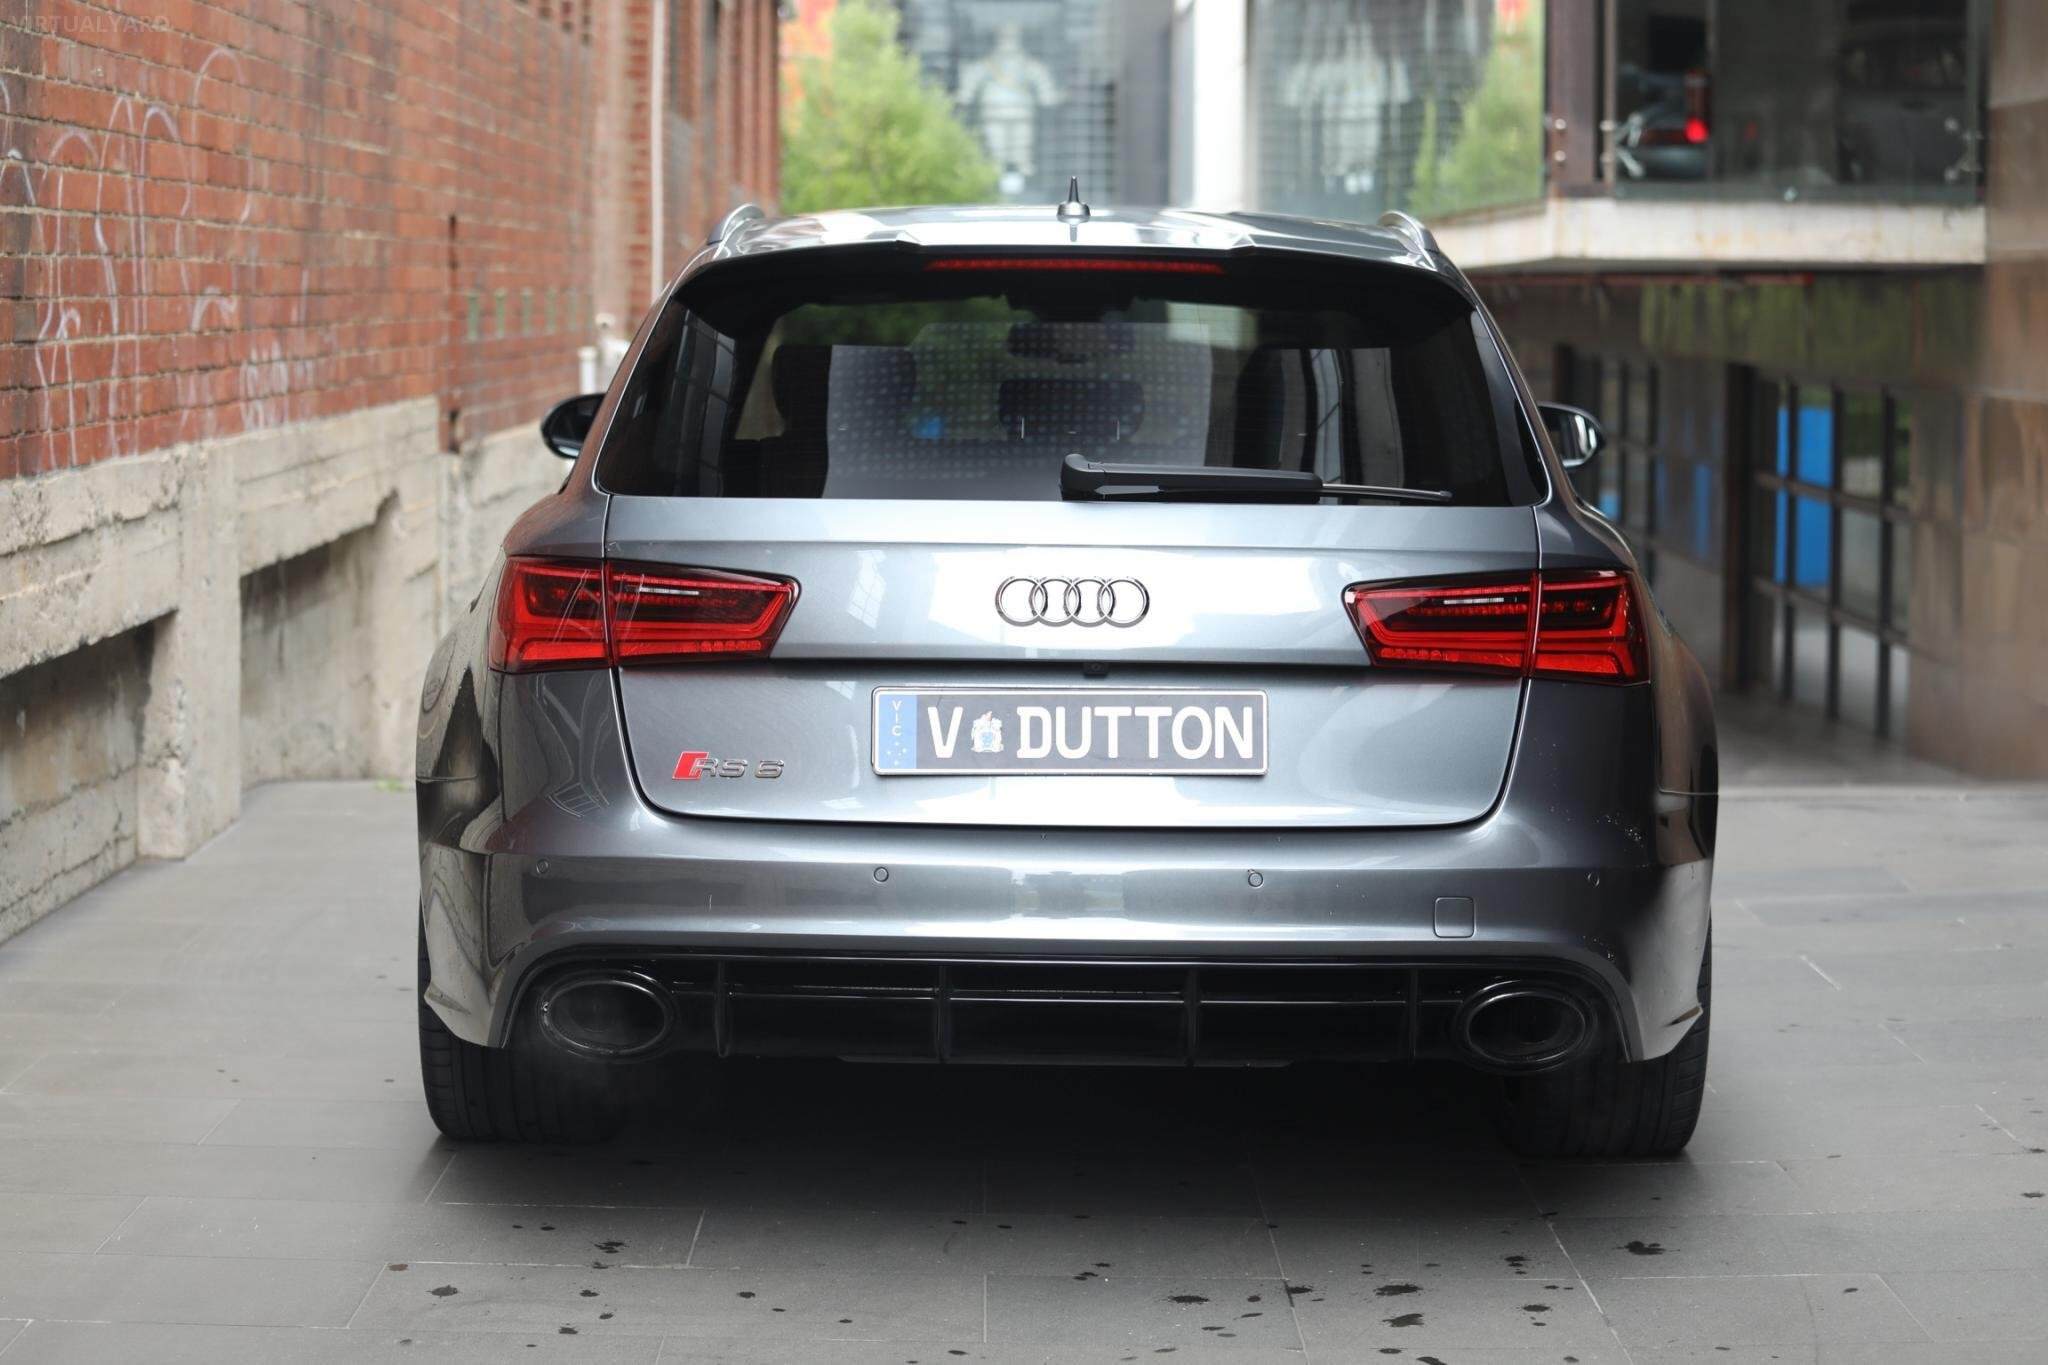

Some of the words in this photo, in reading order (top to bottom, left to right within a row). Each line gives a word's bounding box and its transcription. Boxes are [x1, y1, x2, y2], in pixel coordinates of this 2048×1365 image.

[891, 700, 902, 736] VIC
[927, 706, 963, 759] V
[1016, 706, 1253, 759] DUTTON
[684, 757, 748, 778] RS
[755, 759, 784, 778] 6
